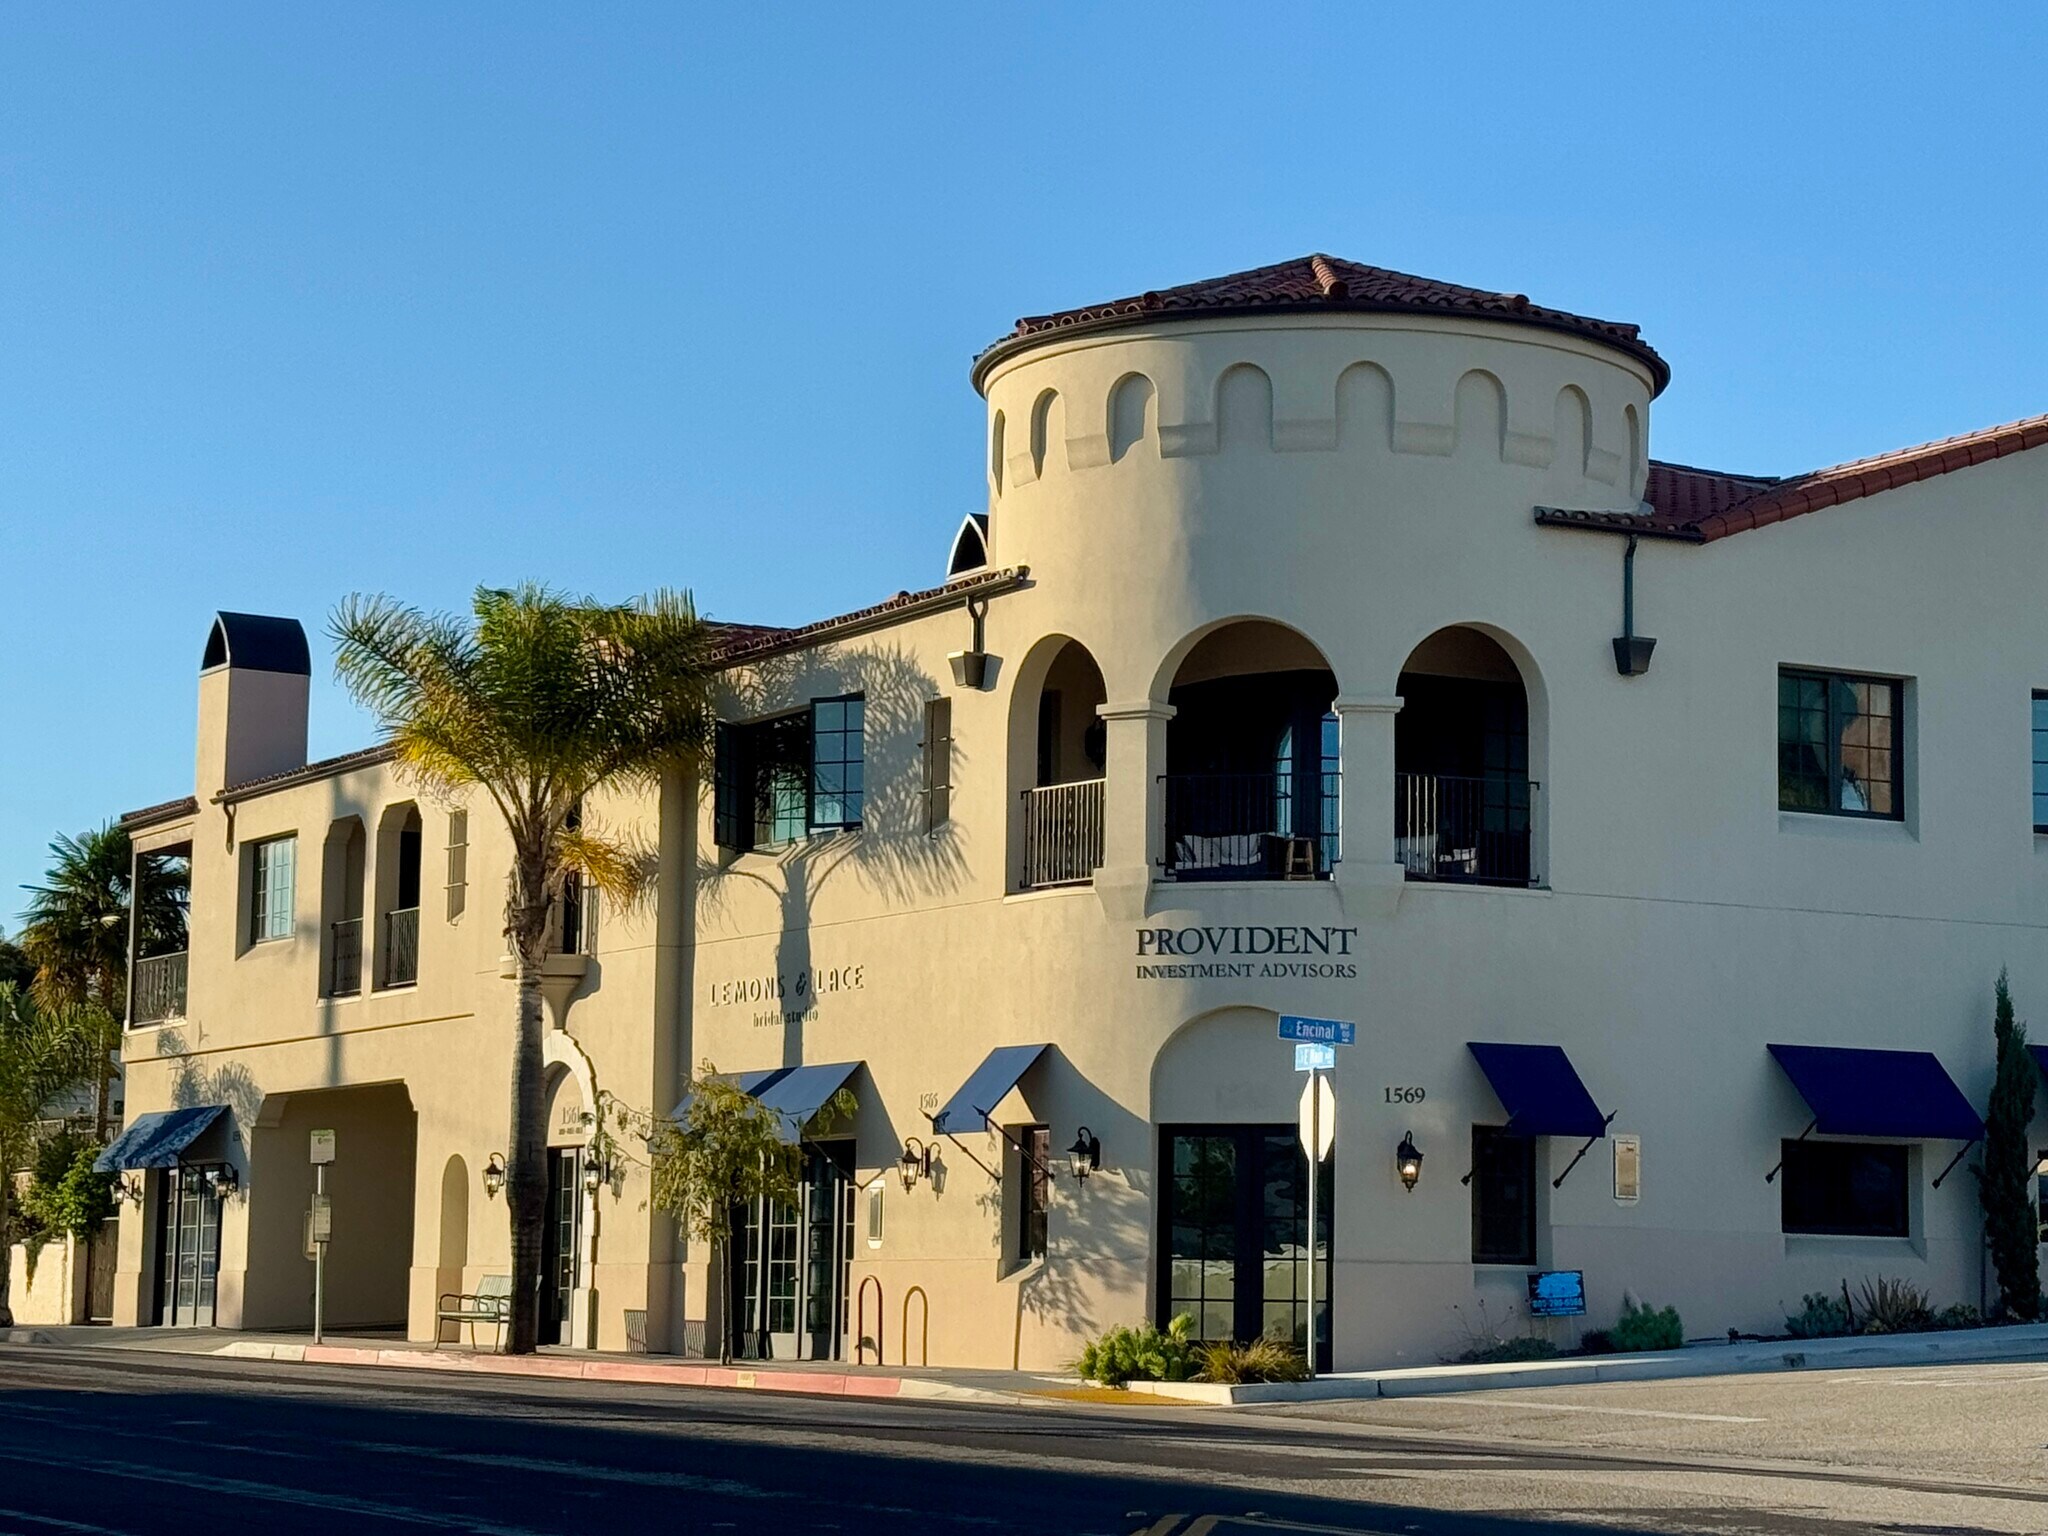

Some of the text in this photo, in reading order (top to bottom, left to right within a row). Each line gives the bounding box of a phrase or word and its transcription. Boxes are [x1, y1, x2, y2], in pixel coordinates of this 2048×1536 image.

[1136, 926, 1358, 956] PROVIDENT
[1136, 962, 1358, 979] INVESTMENT ADVISORS
[710, 963, 865, 1007] LEMONS & LACE
[753, 1006, 819, 1028] bridal studio
[1296, 1020, 1336, 1040] Encinal
[1384, 1086, 1426, 1104] 1569
